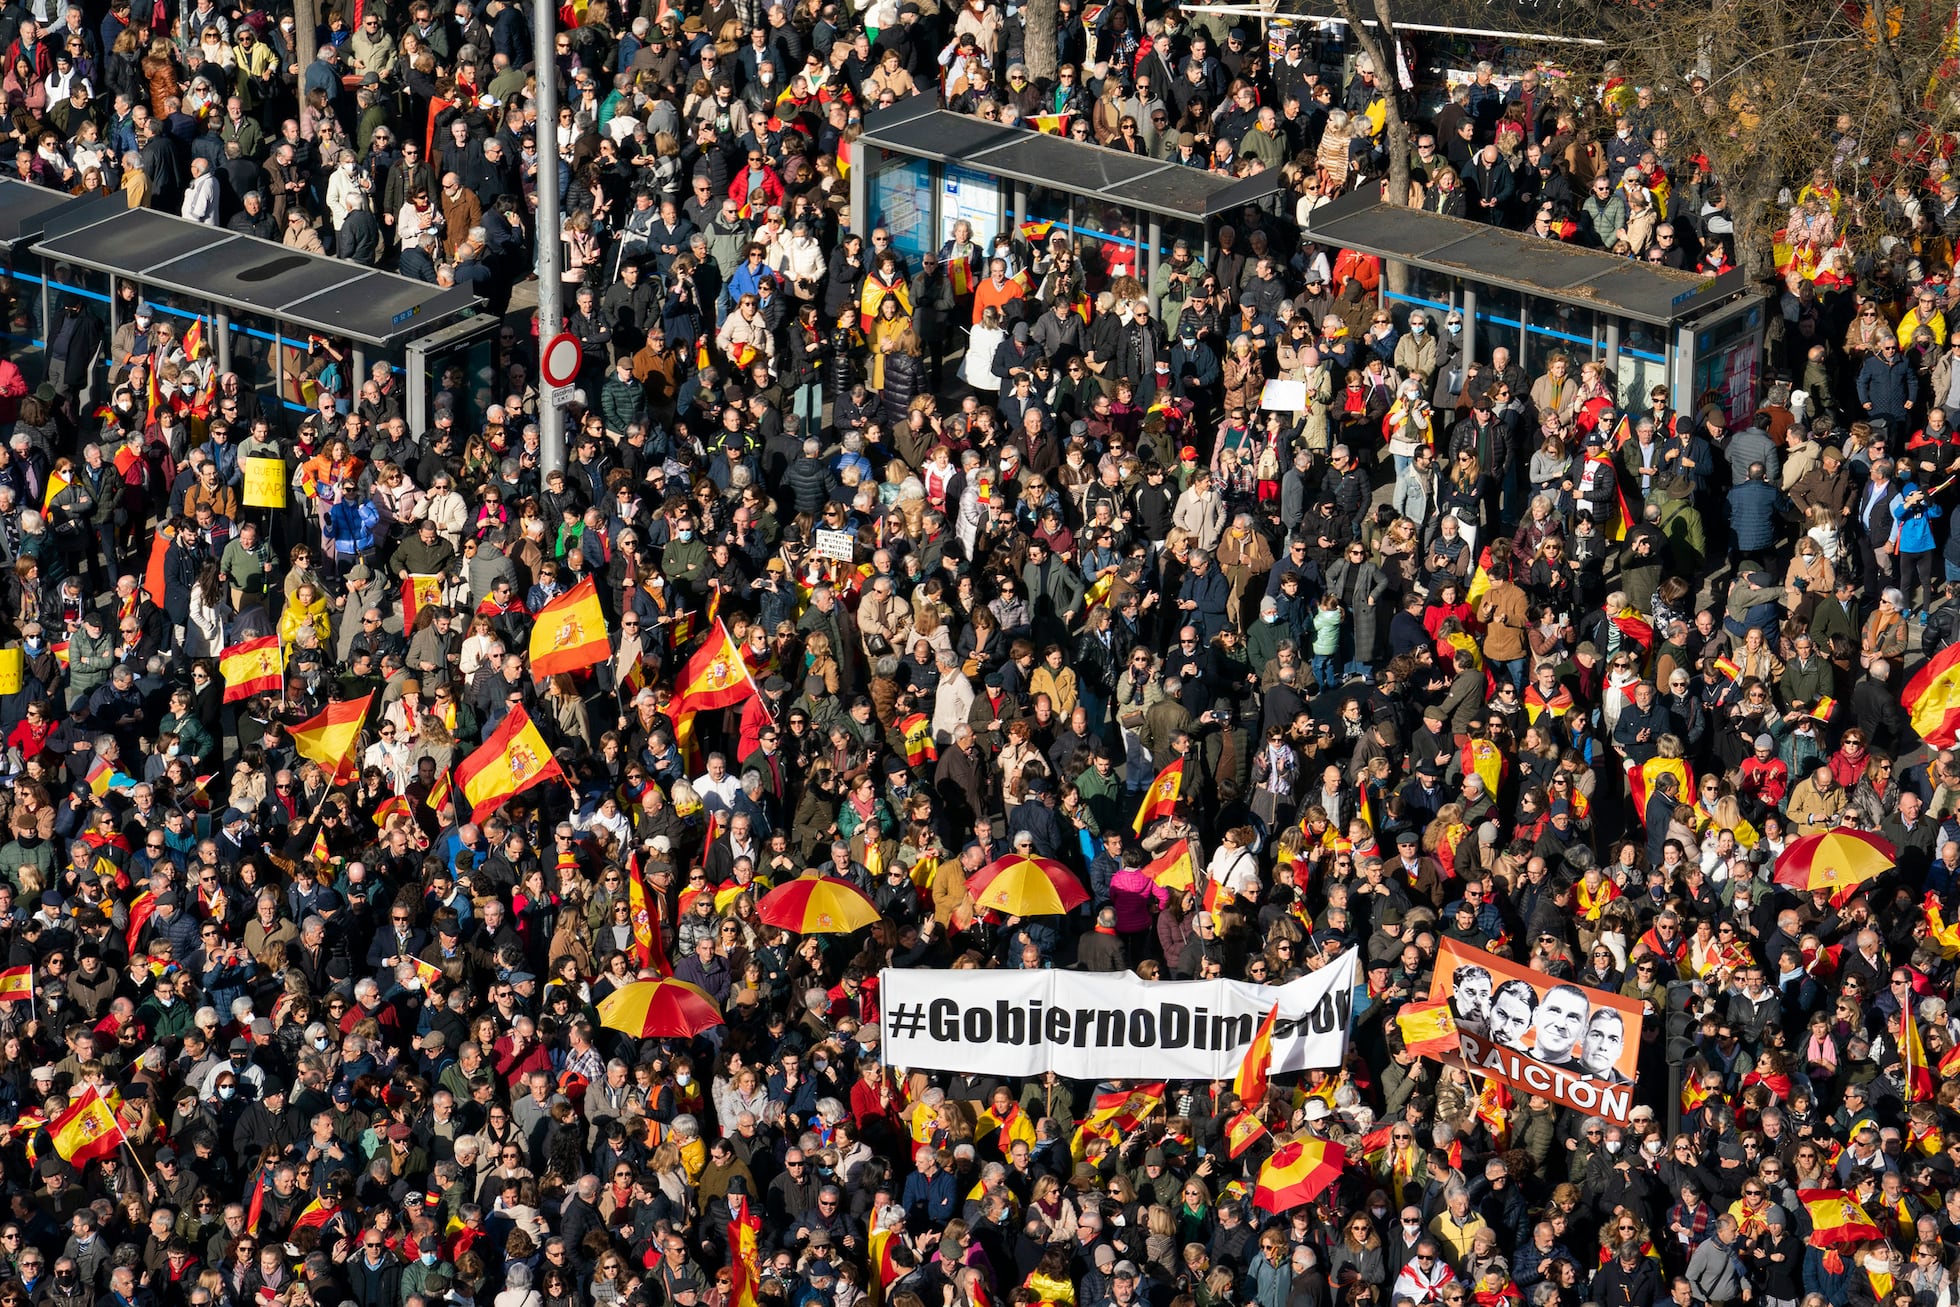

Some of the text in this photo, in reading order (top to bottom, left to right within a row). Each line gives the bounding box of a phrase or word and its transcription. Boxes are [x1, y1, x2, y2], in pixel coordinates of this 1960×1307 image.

[553, 386, 573, 398] EXCEPTO
[253, 466, 281, 477] QUE TE
[1445, 1034, 1630, 1121] RAICIÓN
